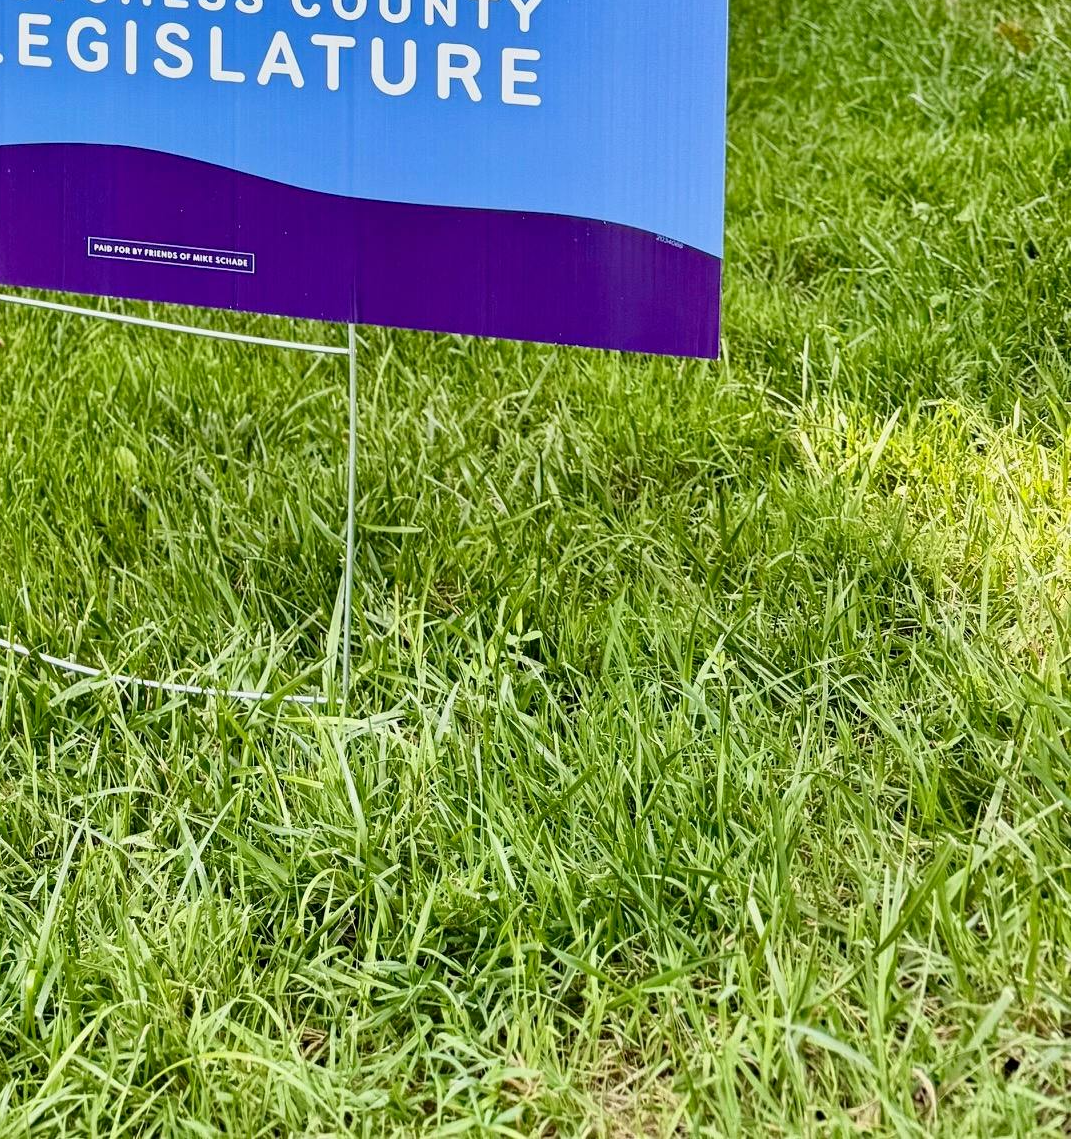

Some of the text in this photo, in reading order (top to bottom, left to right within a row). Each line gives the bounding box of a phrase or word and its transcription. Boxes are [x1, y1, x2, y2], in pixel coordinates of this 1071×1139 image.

[93, 243, 248, 267] PAID FOR BY FRIENDS OF MIKE SCHADE
